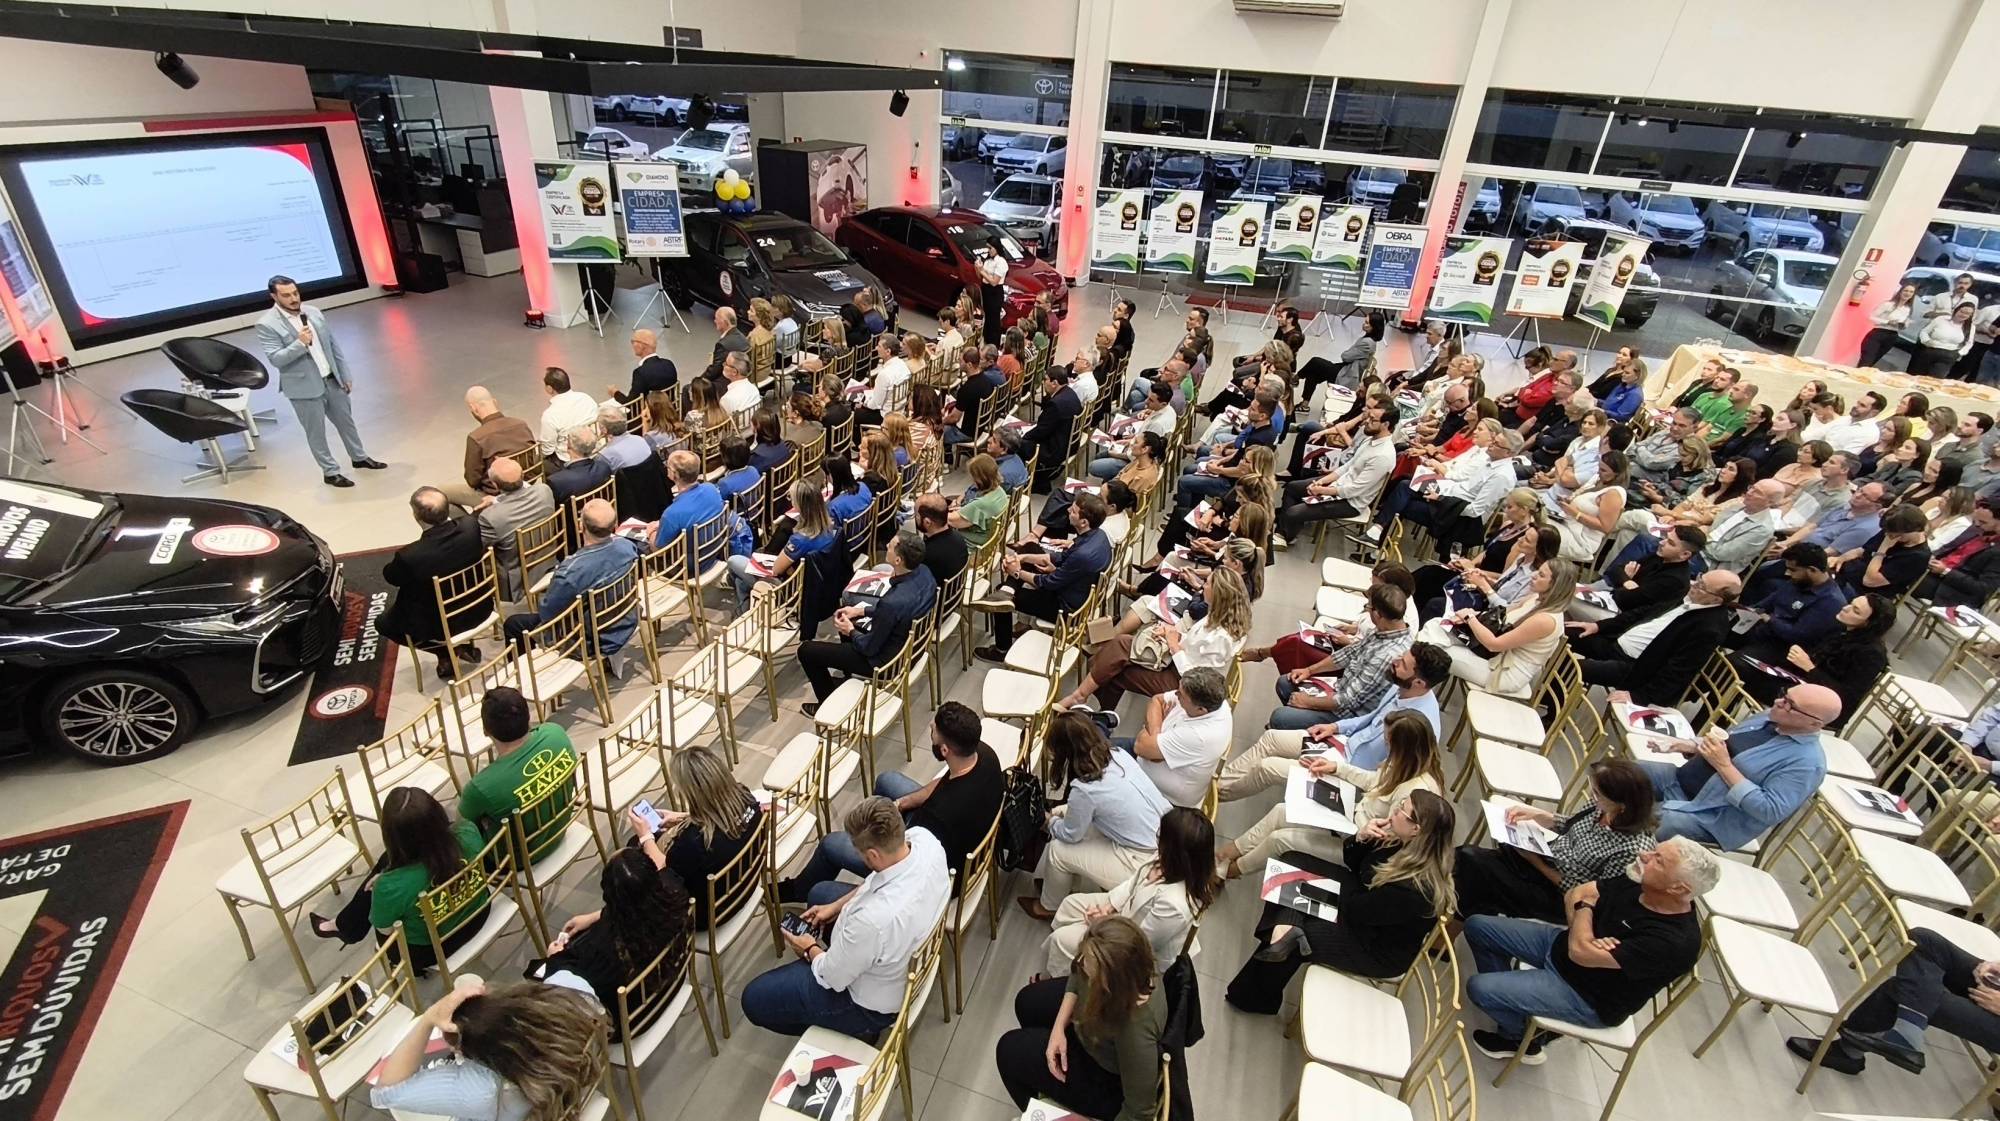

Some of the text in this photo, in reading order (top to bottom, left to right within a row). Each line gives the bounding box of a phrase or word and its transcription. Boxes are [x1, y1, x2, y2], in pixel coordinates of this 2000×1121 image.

[627, 193, 675, 208] CIDADÃ
[634, 190, 665, 198] EMPRESA
[757, 237, 776, 247] 24
[1386, 231, 1413, 241] OBRA
[1374, 250, 1416, 263] CIDADÃ
[1383, 246, 1410, 254] EMPRESA
[4, 518, 51, 560] WEIAND
[358, 636, 380, 662] SEM
[516, 751, 575, 804] HAVAN
[33, 844, 72, 863] DE
[0, 916, 109, 1101] SEM DÚVIDAS
